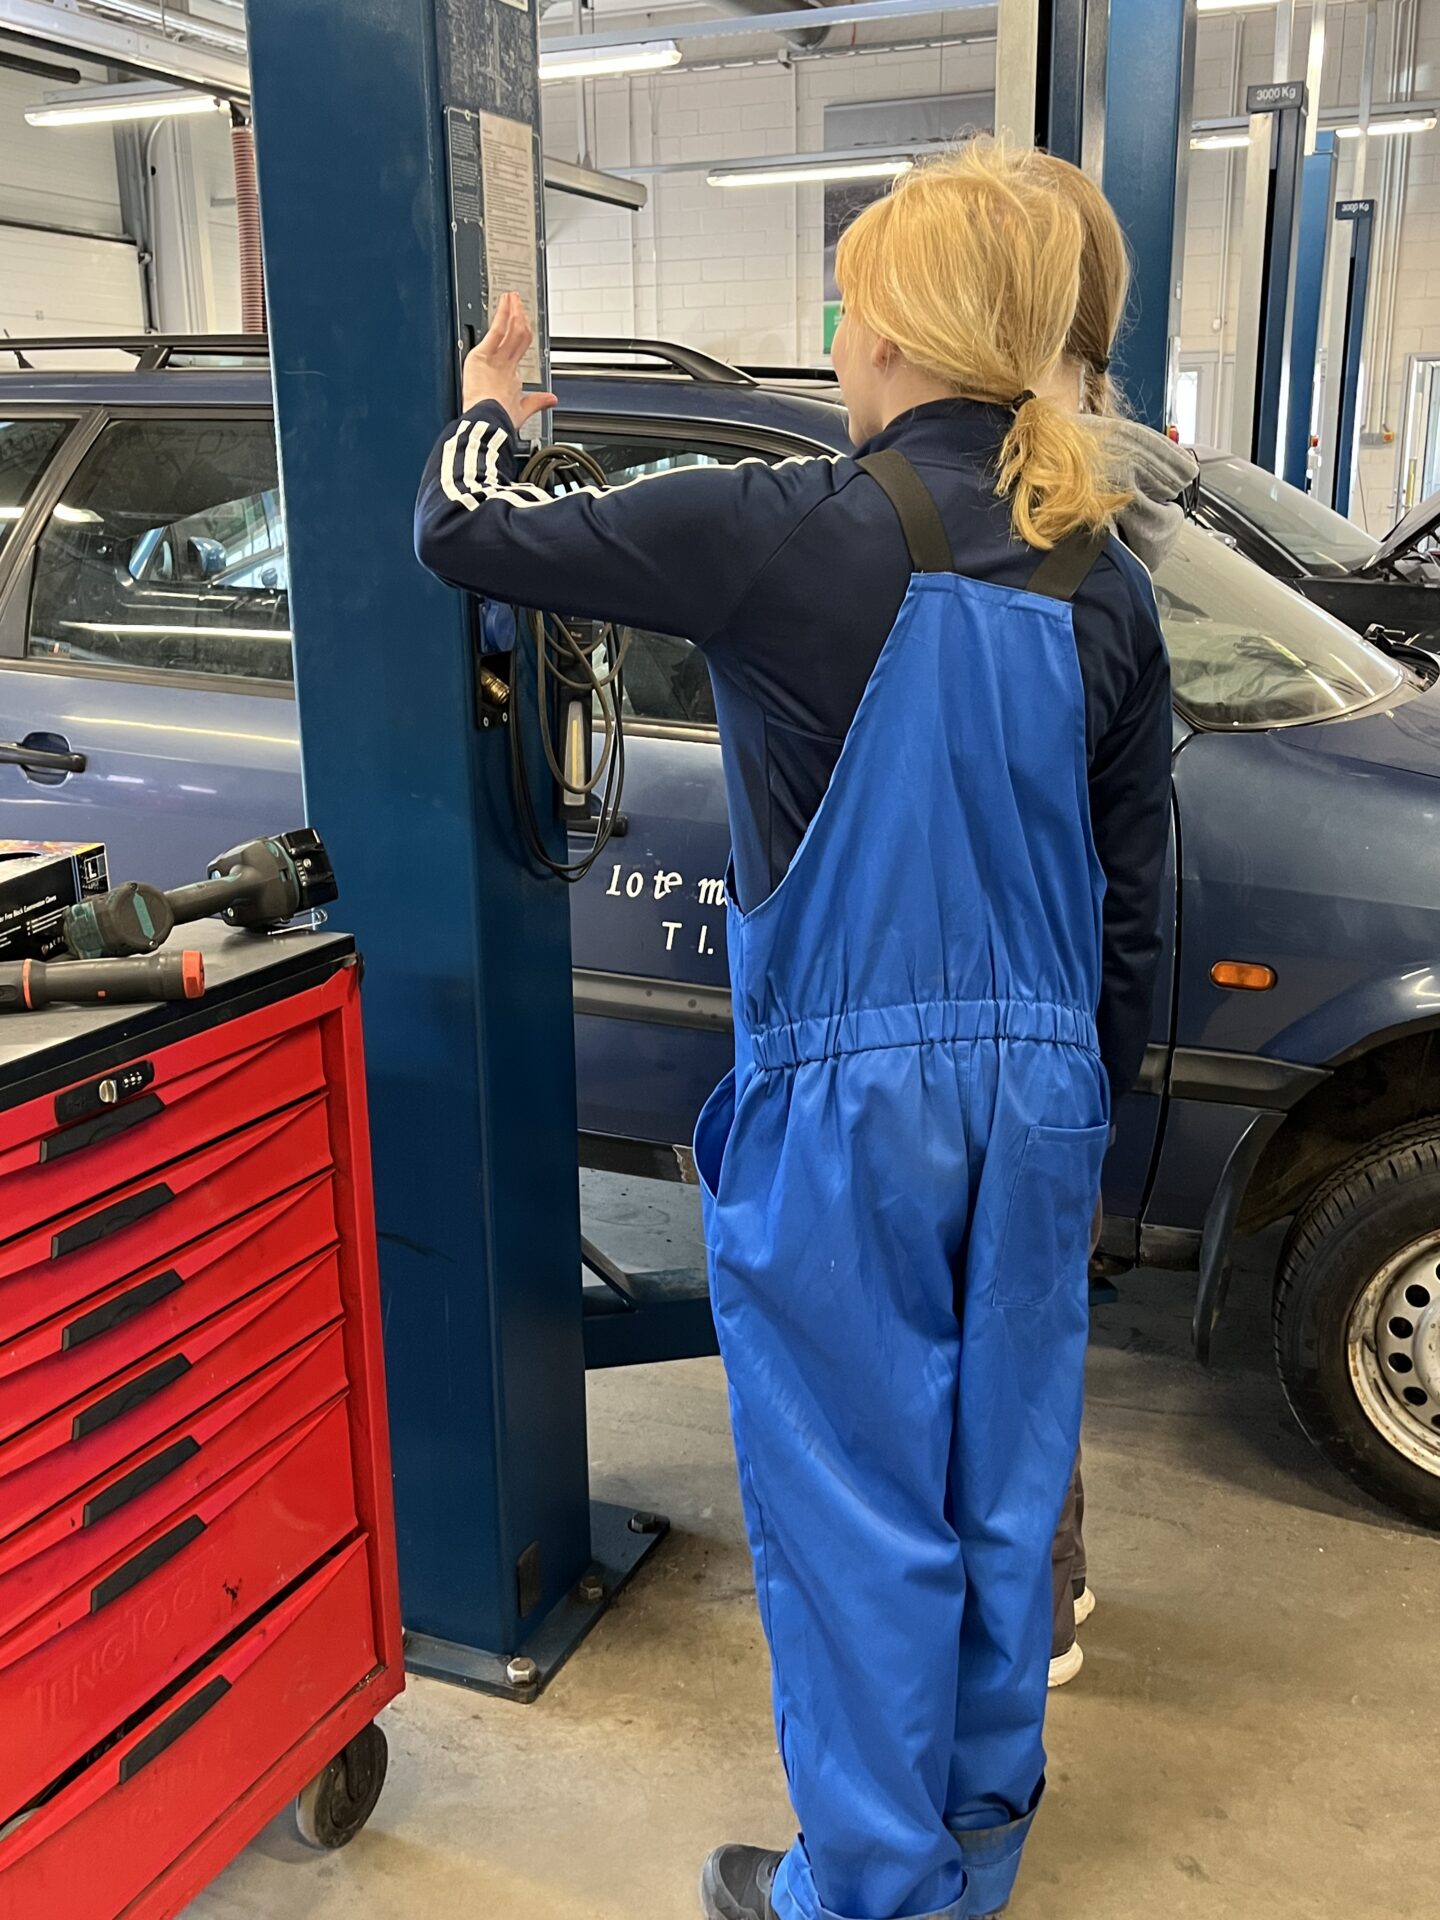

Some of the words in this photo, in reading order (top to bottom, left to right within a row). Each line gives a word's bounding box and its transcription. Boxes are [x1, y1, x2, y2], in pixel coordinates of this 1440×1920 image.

[1256, 87, 1280, 101] 3000
[1281, 85, 1296, 100] Kg
[1341, 202, 1358, 212] 3000
[1359, 201, 1370, 212] Kg
[88, 861, 97, 879] L
